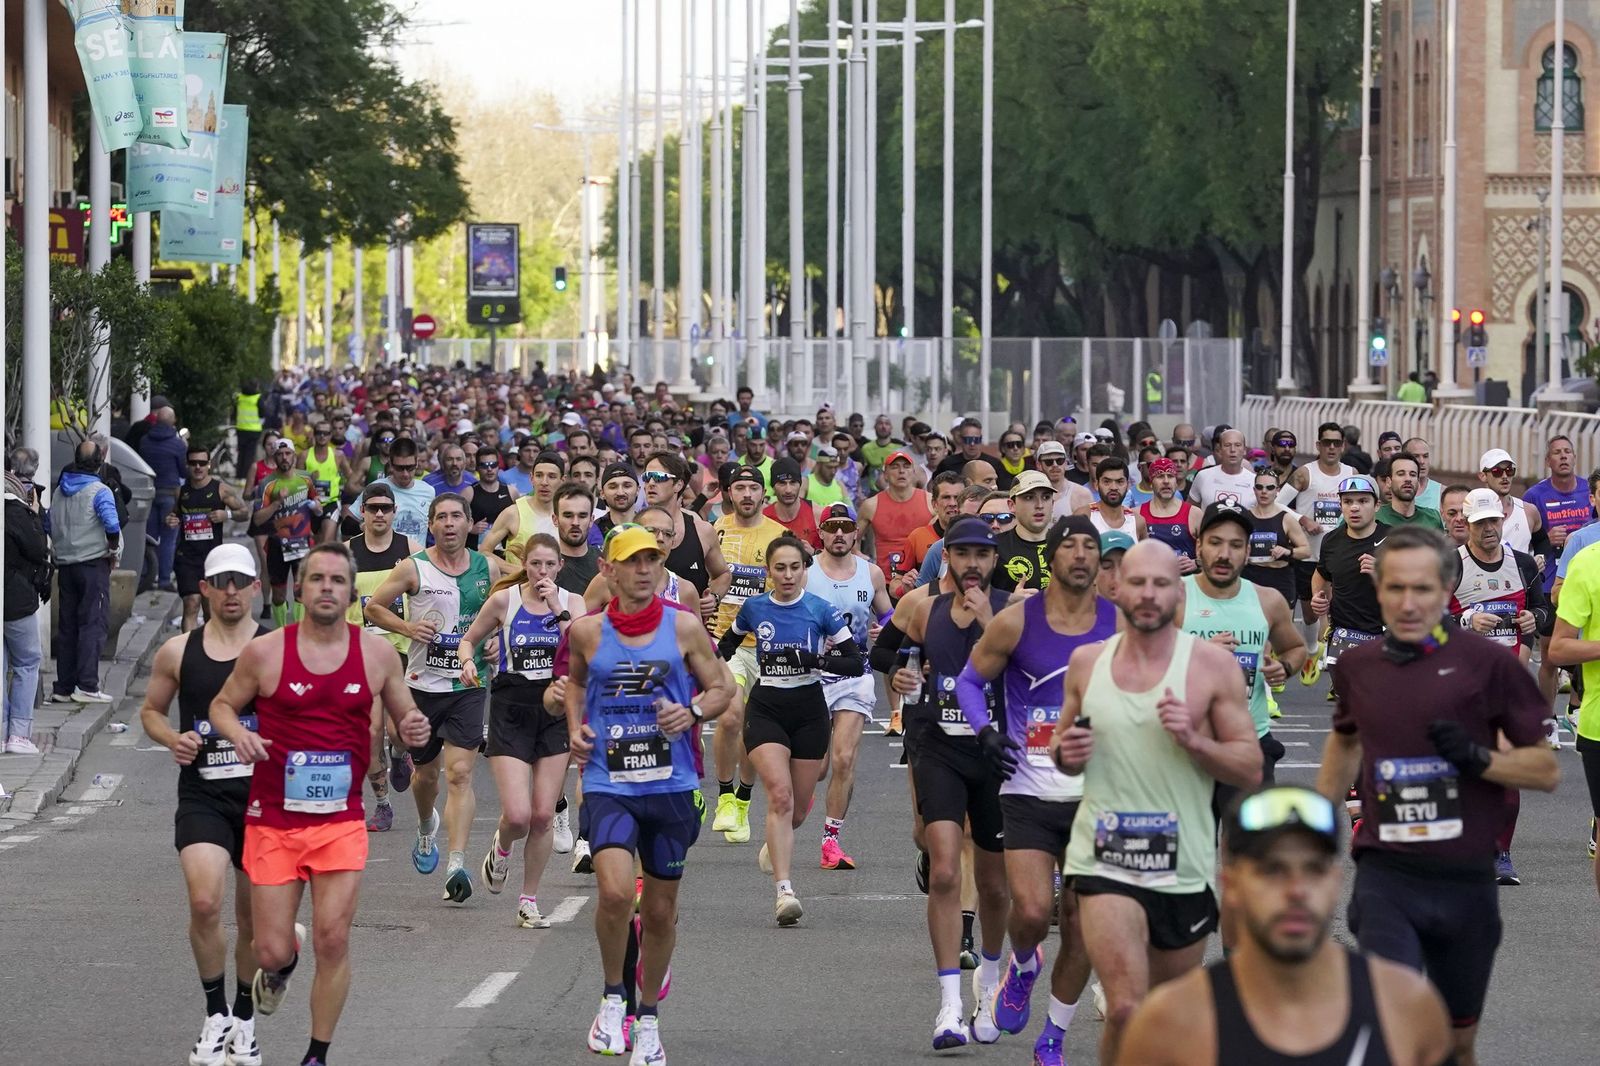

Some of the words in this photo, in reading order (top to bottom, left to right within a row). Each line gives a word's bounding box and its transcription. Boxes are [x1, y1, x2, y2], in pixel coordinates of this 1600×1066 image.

[736, 567, 762, 575] ZURICH
[736, 578, 750, 586] 4915
[857, 590, 868, 602] RB
[1486, 603, 1512, 611] ZURICH
[529, 636, 559, 644] ZURICH
[1349, 632, 1376, 641] ZURICH
[426, 656, 450, 669] JOSÉ
[523, 655, 554, 669] CHLOÉ
[629, 743, 649, 753] 4094
[310, 754, 345, 764] ZURICH
[623, 754, 657, 770] FRAN
[306, 785, 334, 799] SEVI
[1394, 801, 1438, 822] YEYU
[1122, 816, 1169, 828] ZURICH
[1102, 850, 1170, 870] GRAHAM
